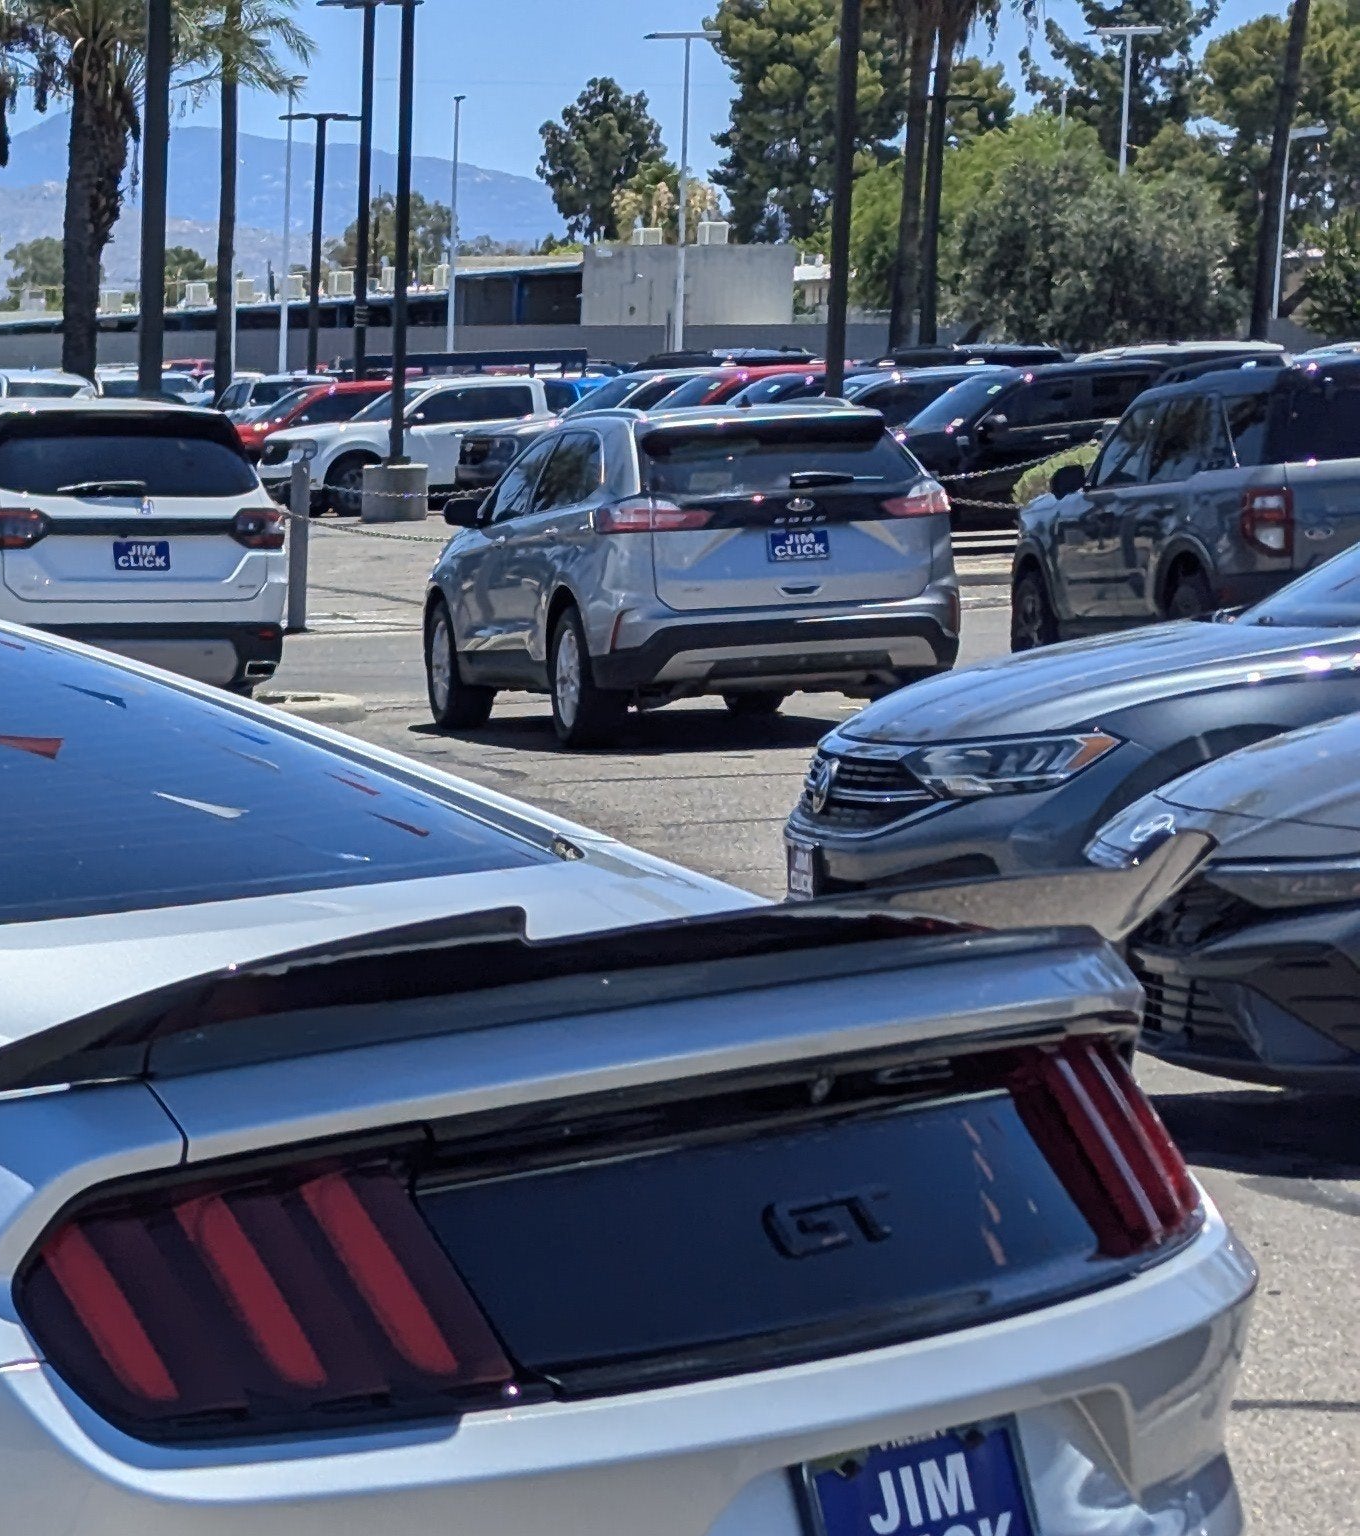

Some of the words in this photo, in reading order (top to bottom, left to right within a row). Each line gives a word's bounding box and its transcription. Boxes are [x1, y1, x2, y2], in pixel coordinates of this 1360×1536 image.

[785, 532, 816, 545] JIM
[128, 544, 156, 556] JIM
[774, 543, 826, 557] CLICK
[118, 555, 167, 568] CLICK
[761, 1189, 893, 1261] GT
[869, 1452, 976, 1535] JIM
